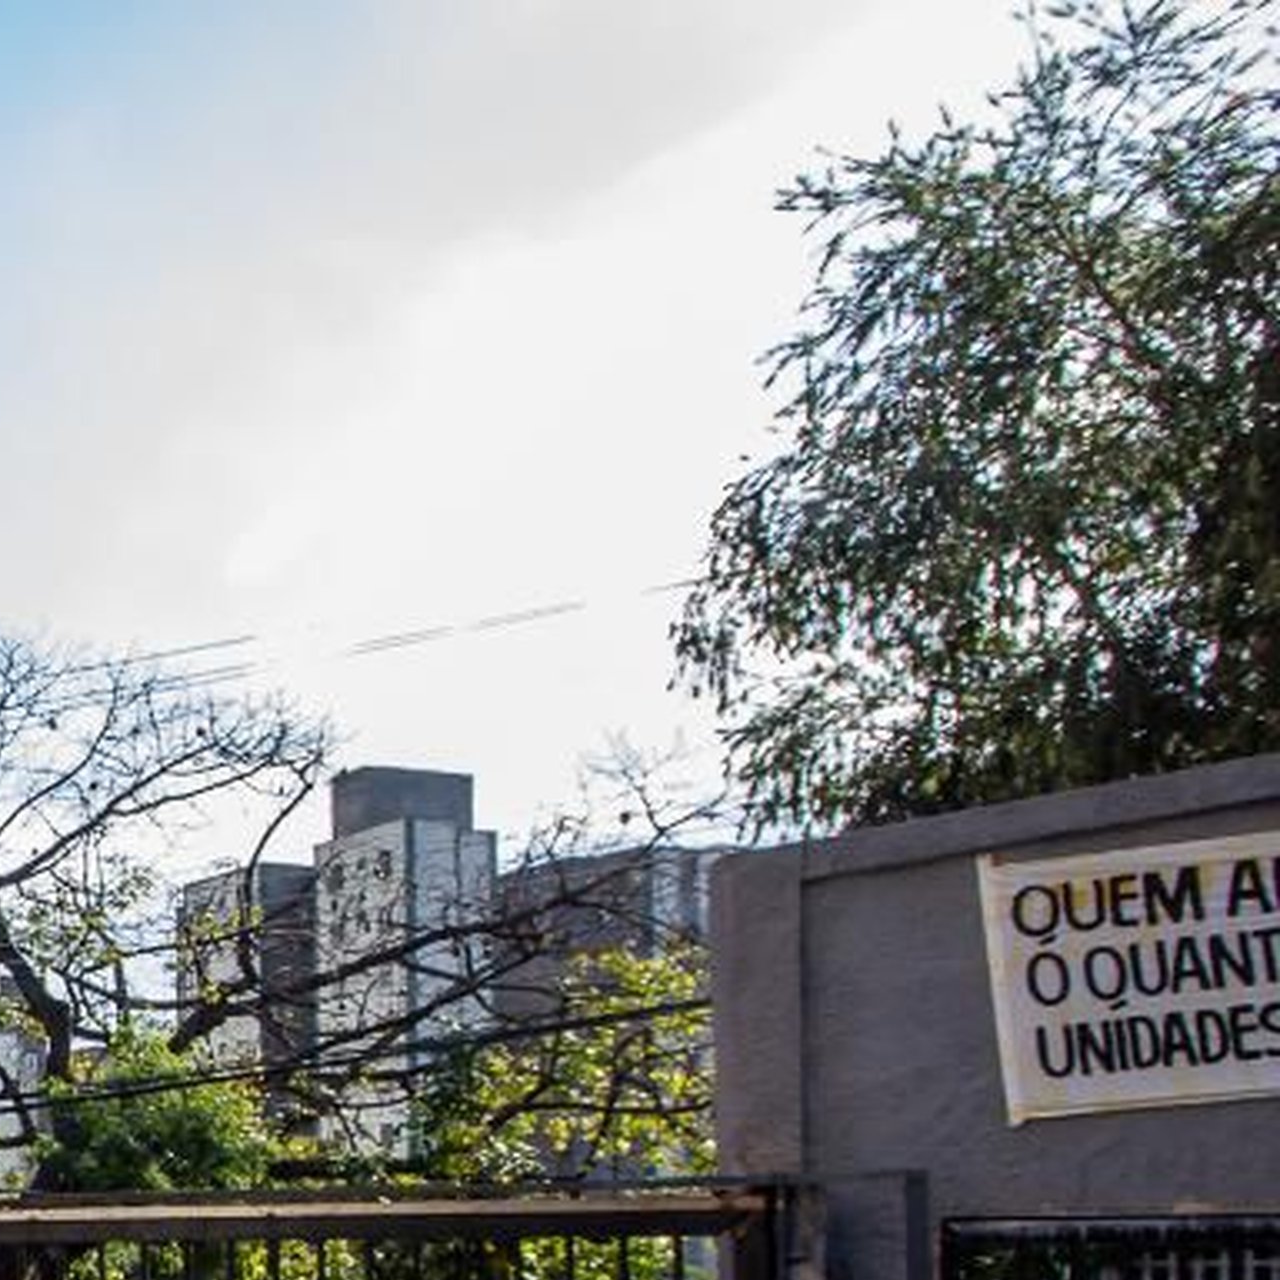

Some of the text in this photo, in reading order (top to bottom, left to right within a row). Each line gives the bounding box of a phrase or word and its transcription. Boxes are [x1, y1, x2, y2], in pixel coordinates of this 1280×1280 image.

[1012, 857, 1280, 945] QUEM A
[1026, 951, 1071, 1007] O
